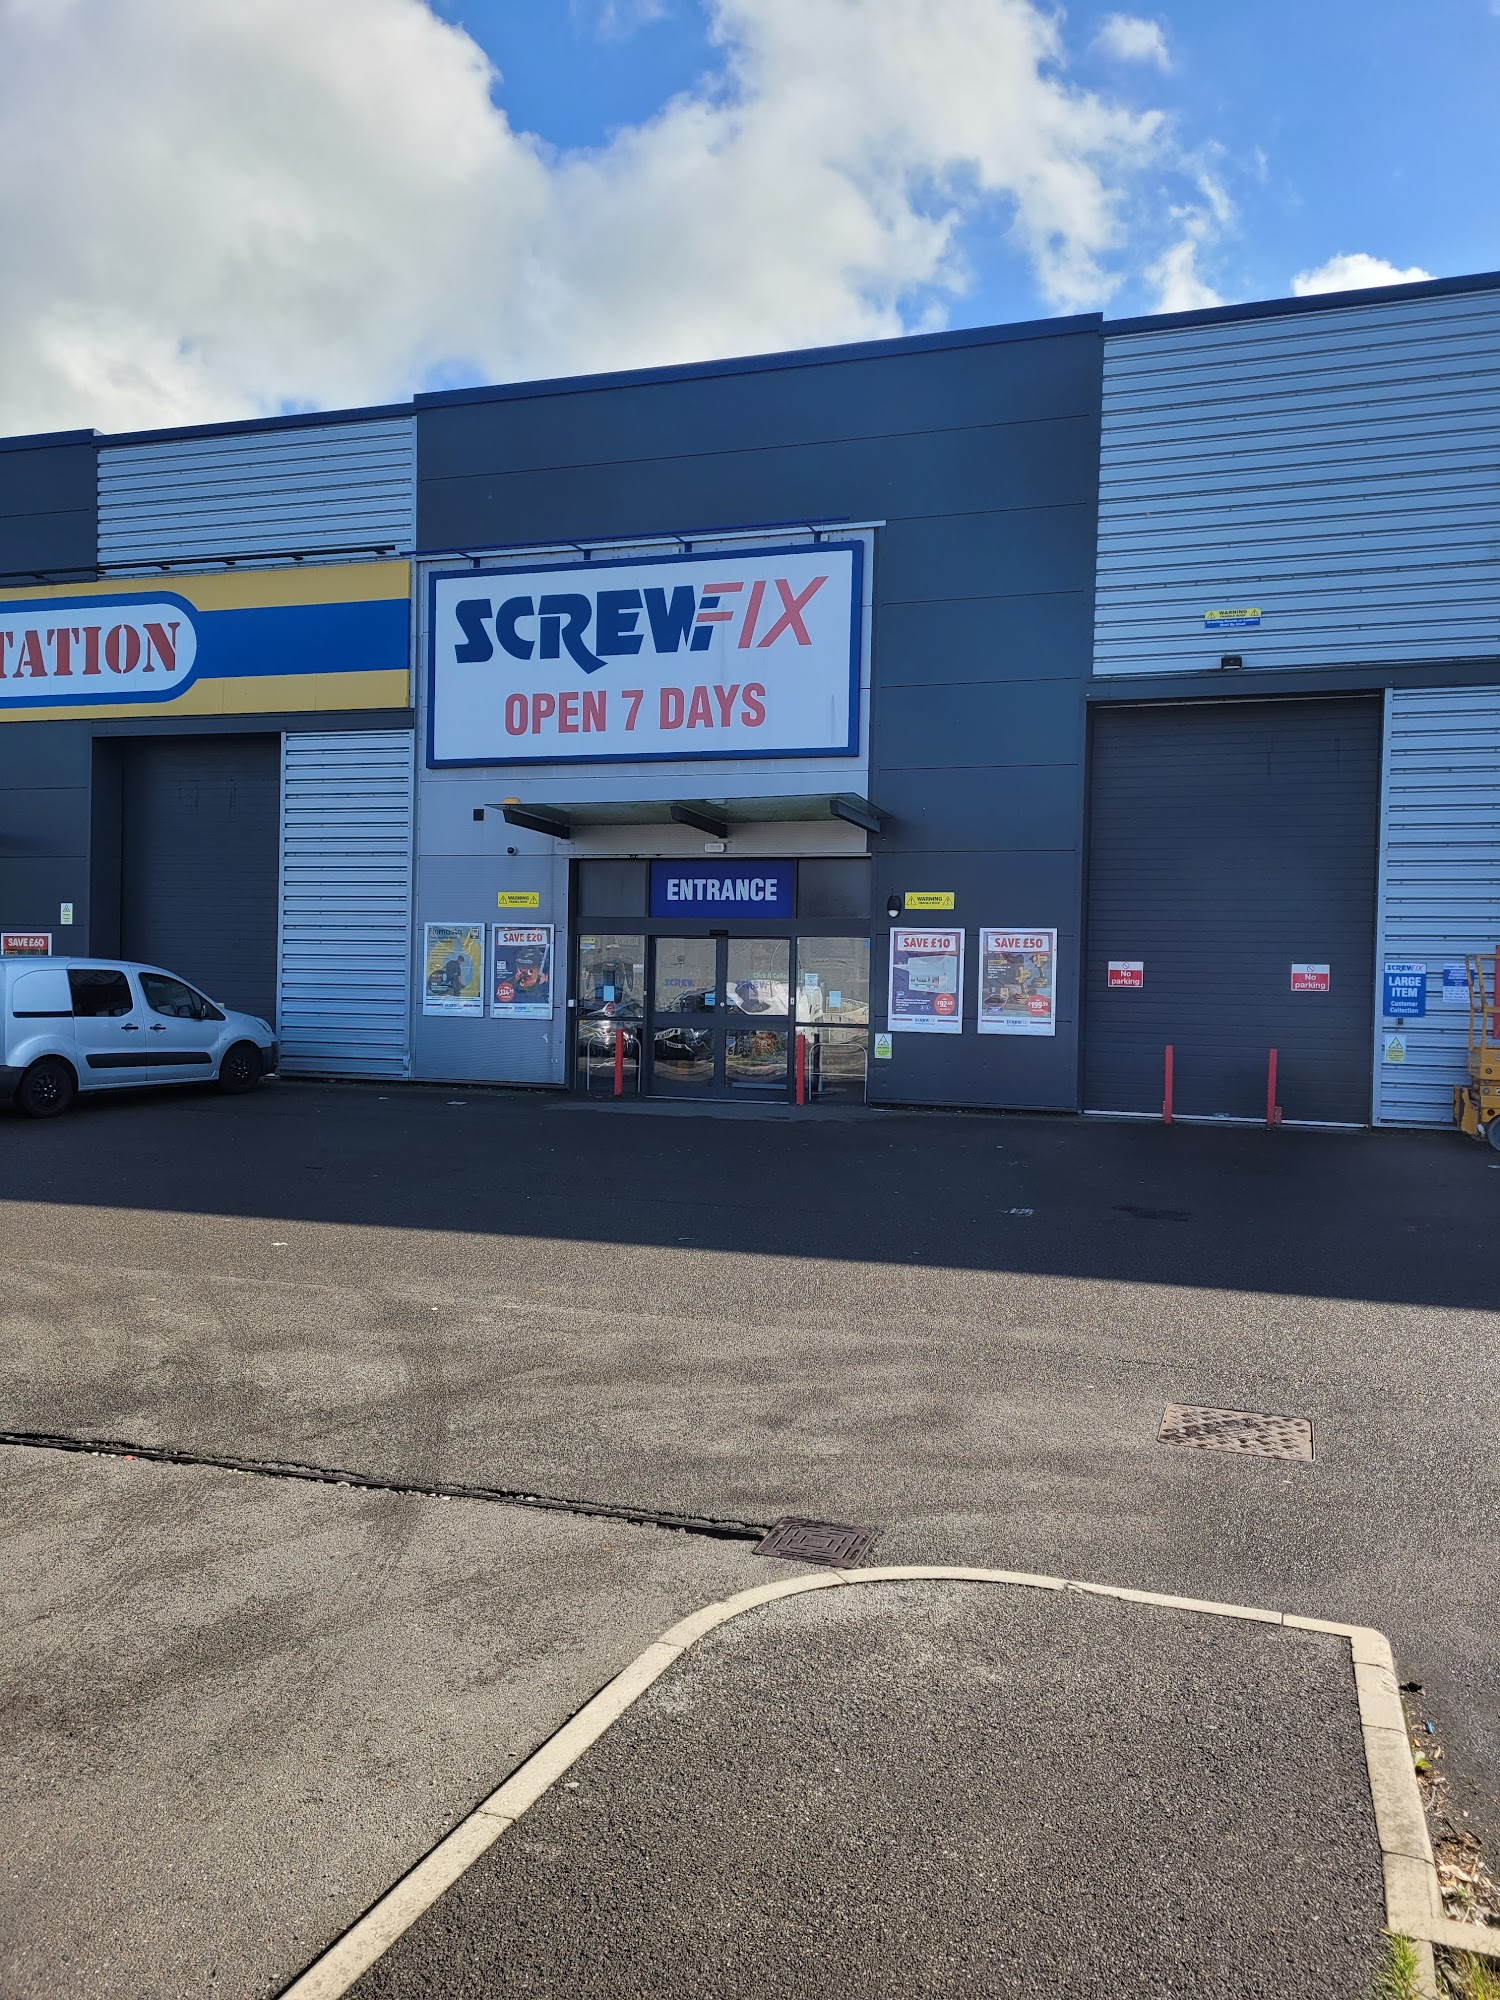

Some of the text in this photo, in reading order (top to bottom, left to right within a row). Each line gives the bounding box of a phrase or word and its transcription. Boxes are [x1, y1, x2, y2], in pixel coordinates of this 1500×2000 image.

[454, 576, 829, 674] SCREWFIX
[505, 682, 766, 736] OPEN 7 DAYS
[666, 878, 778, 901] ENTRANCE
[8, 937, 45, 947] SAVE £60
[503, 933, 543, 943] SAVE £20
[903, 937, 951, 949] SAVE £10
[994, 937, 1043, 949] SAVE £50
[1386, 964, 1424, 972] SCREWFIX
[1111, 978, 1140, 986] parking
[1304, 973, 1317, 981] No
[1388, 976, 1422, 987] LARGE
[1294, 981, 1326, 990] parking
[1391, 987, 1418, 998] ITEM
